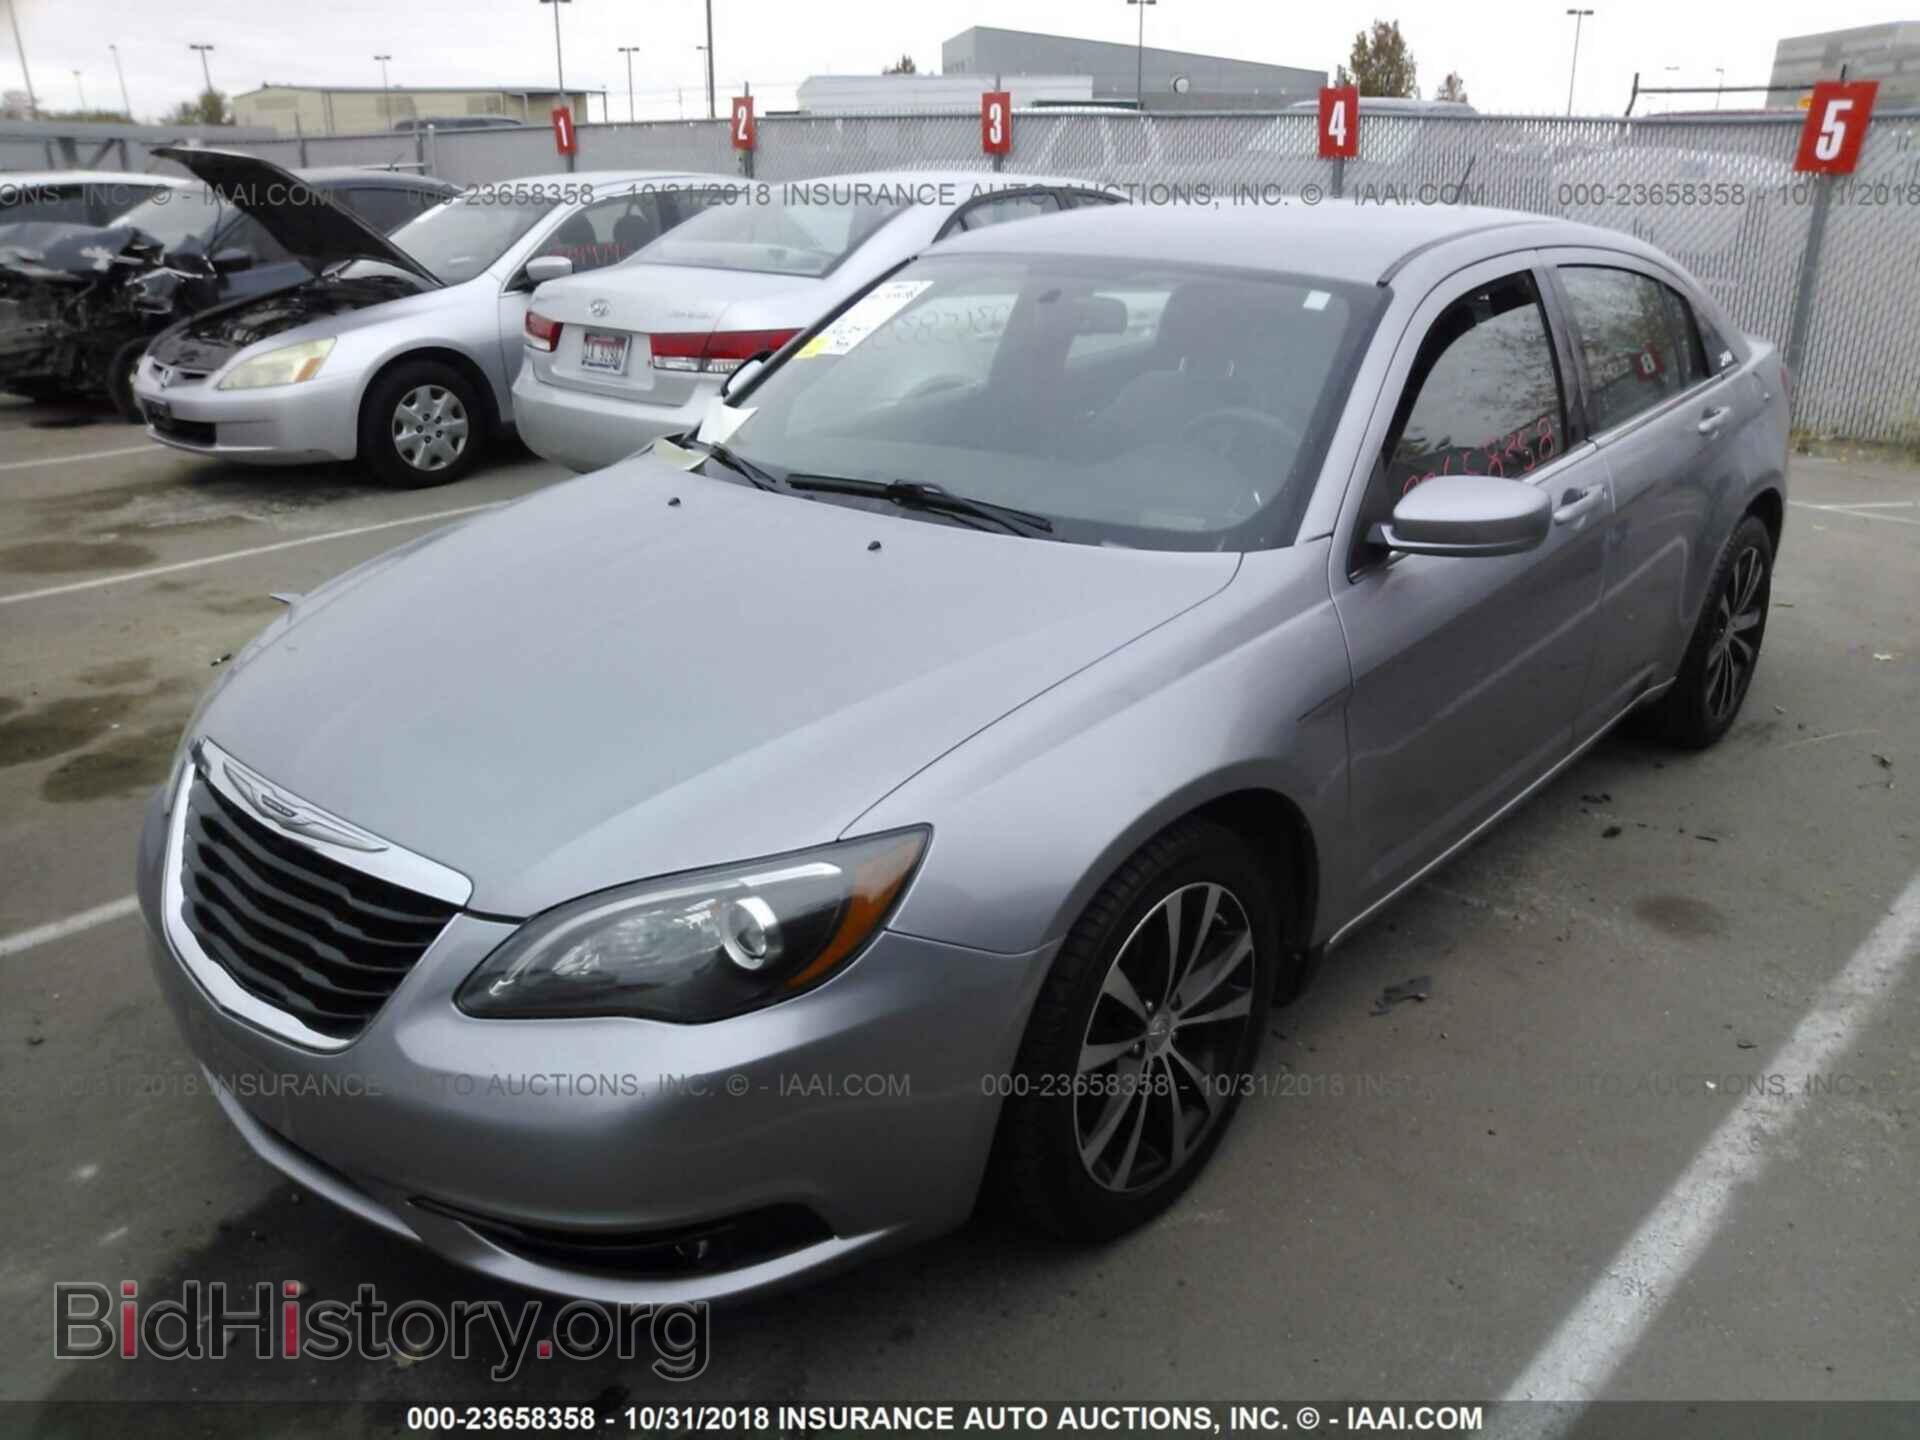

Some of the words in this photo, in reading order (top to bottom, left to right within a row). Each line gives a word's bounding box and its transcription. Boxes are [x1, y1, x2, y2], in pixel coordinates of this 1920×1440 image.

[558, 117, 568, 148] 1
[737, 106, 748, 141] 2
[989, 102, 1003, 144] 3
[1328, 101, 1346, 147] 4
[1816, 99, 1853, 161] 5
